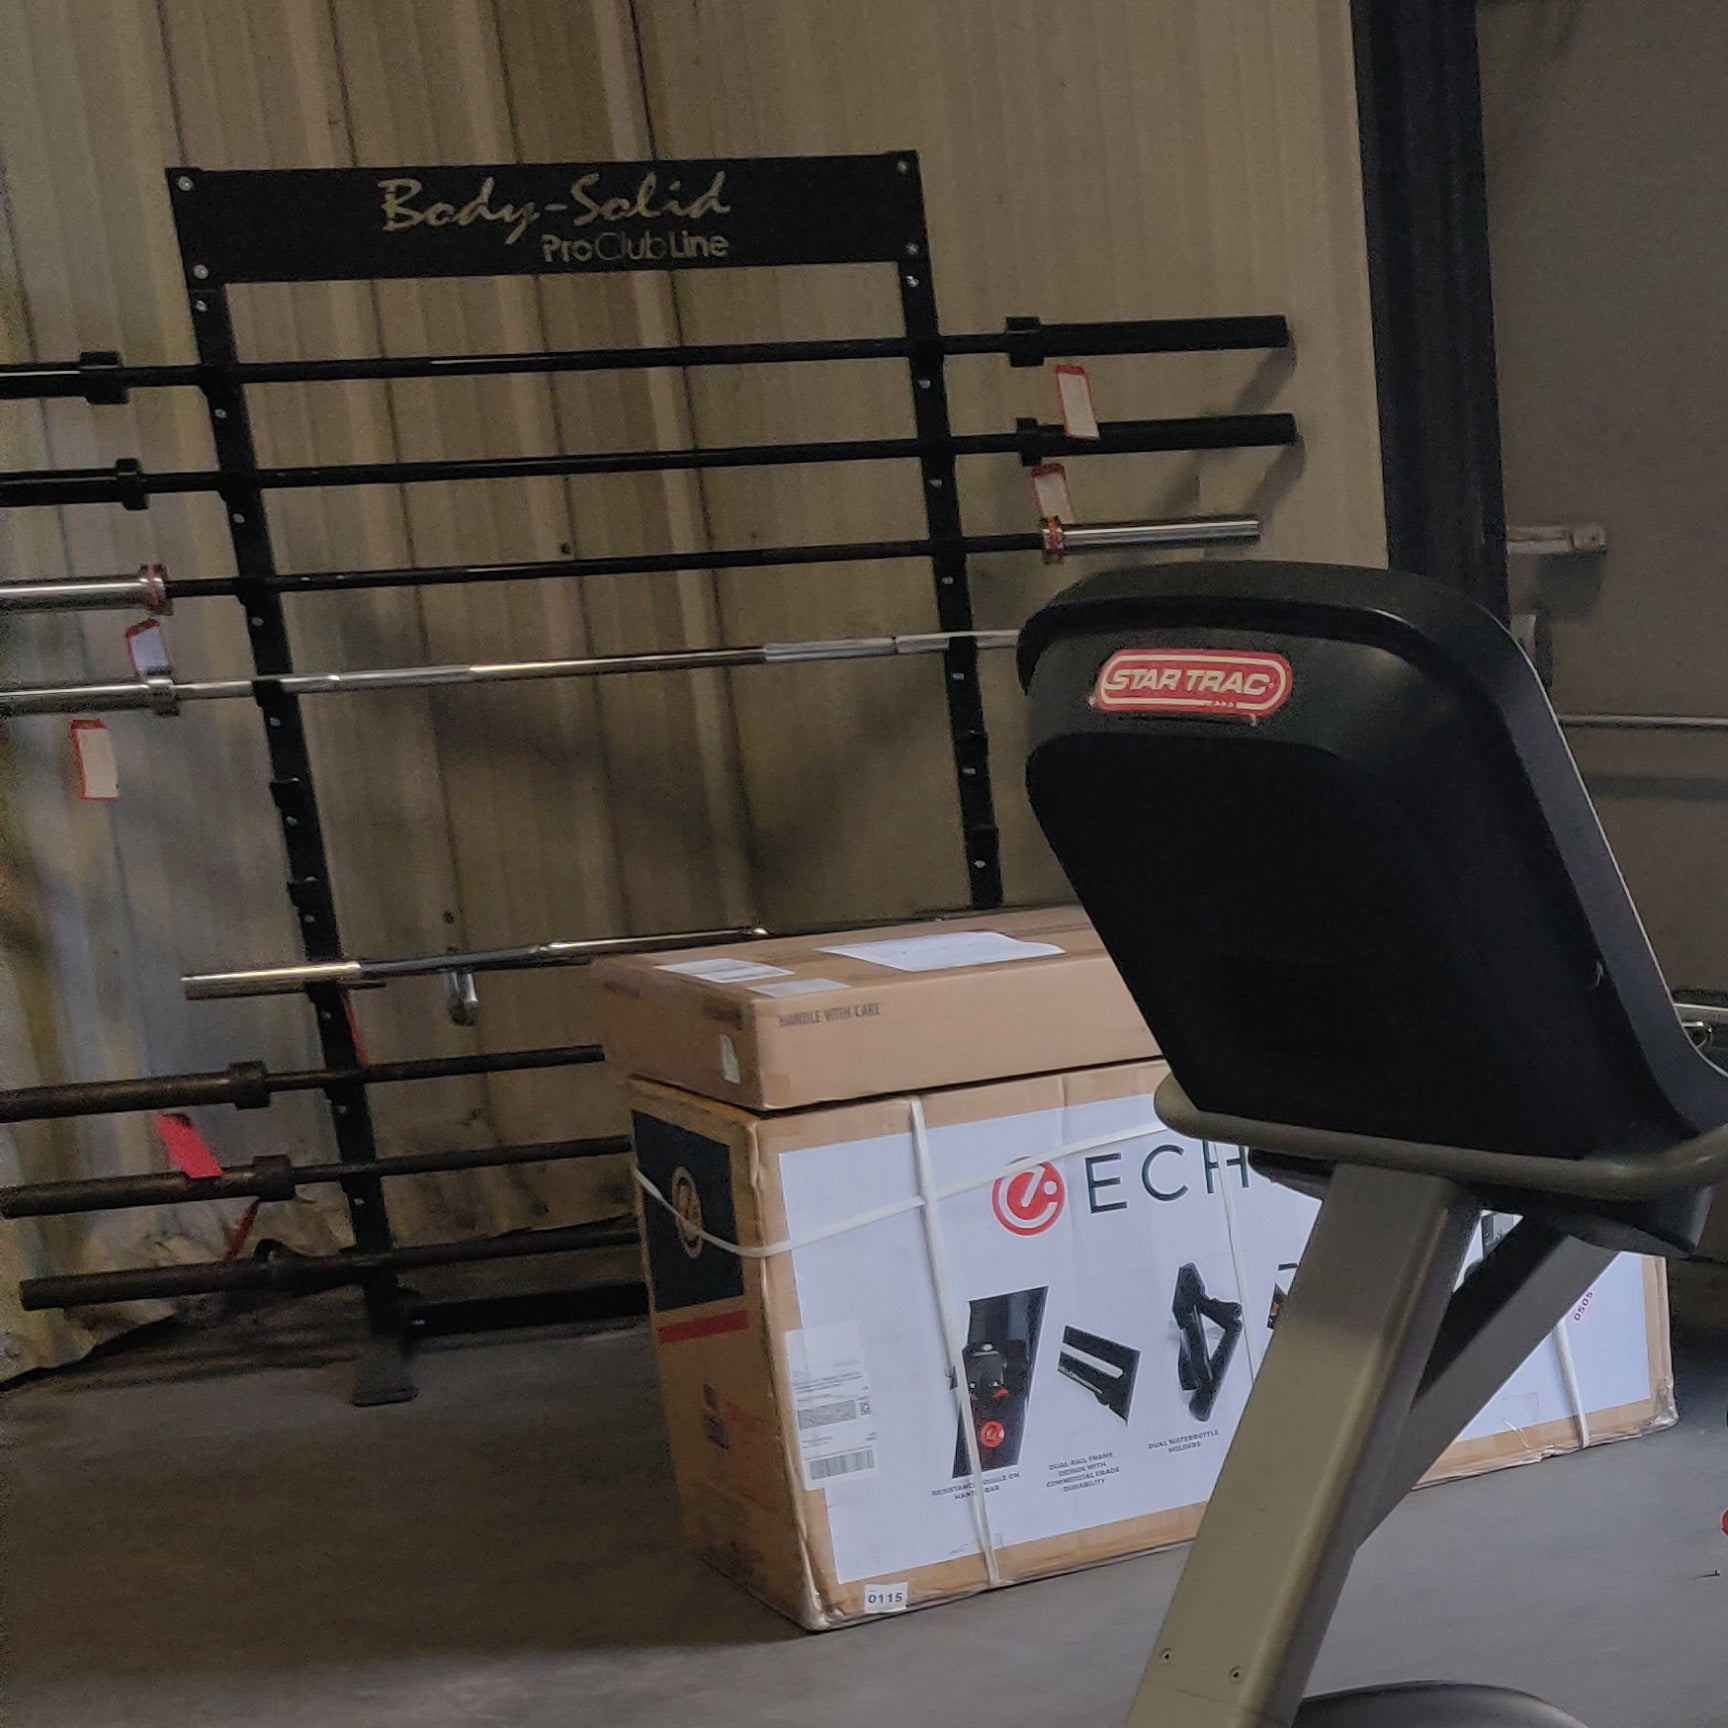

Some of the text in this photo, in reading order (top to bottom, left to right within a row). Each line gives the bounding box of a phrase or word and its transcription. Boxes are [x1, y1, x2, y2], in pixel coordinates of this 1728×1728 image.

[377, 170, 732, 245] Body-Solid
[1102, 668, 1271, 696] STAR TRAC
[780, 1002, 881, 1028] HANDLE WITH CARE
[1084, 1139, 1250, 1215] ECH
[1574, 1291, 1594, 1321] 0505
[867, 1592, 904, 1604] 0115
